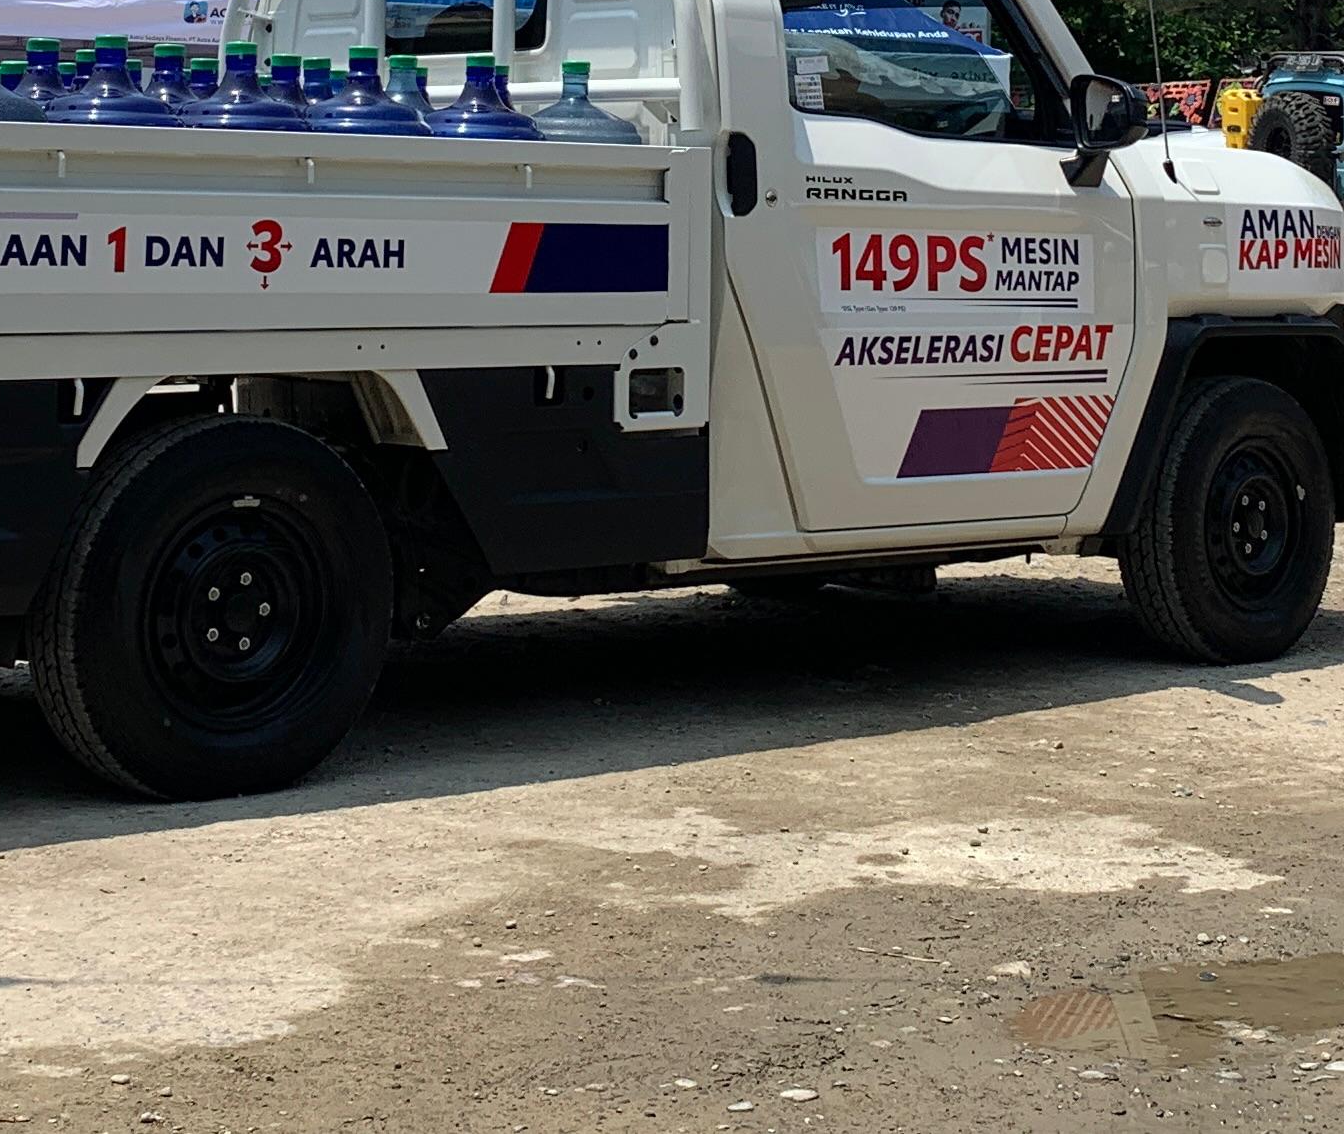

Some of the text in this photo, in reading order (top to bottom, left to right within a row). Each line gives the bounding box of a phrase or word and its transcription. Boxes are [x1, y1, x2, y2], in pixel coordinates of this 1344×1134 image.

[806, 175, 854, 185] HILUX
[806, 187, 907, 202] RANGGA
[1240, 209, 1315, 239] AMAN
[107, 226, 127, 273] 1
[144, 236, 225, 268] DAN
[250, 219, 283, 274] 3
[310, 238, 406, 269] ARAH
[1001, 237, 1079, 265] MESIN
[1238, 236, 1342, 270] KAP MESIN
[995, 270, 1080, 292] MANTAP
[834, 324, 1114, 366] AKSELERASI CEPAT
